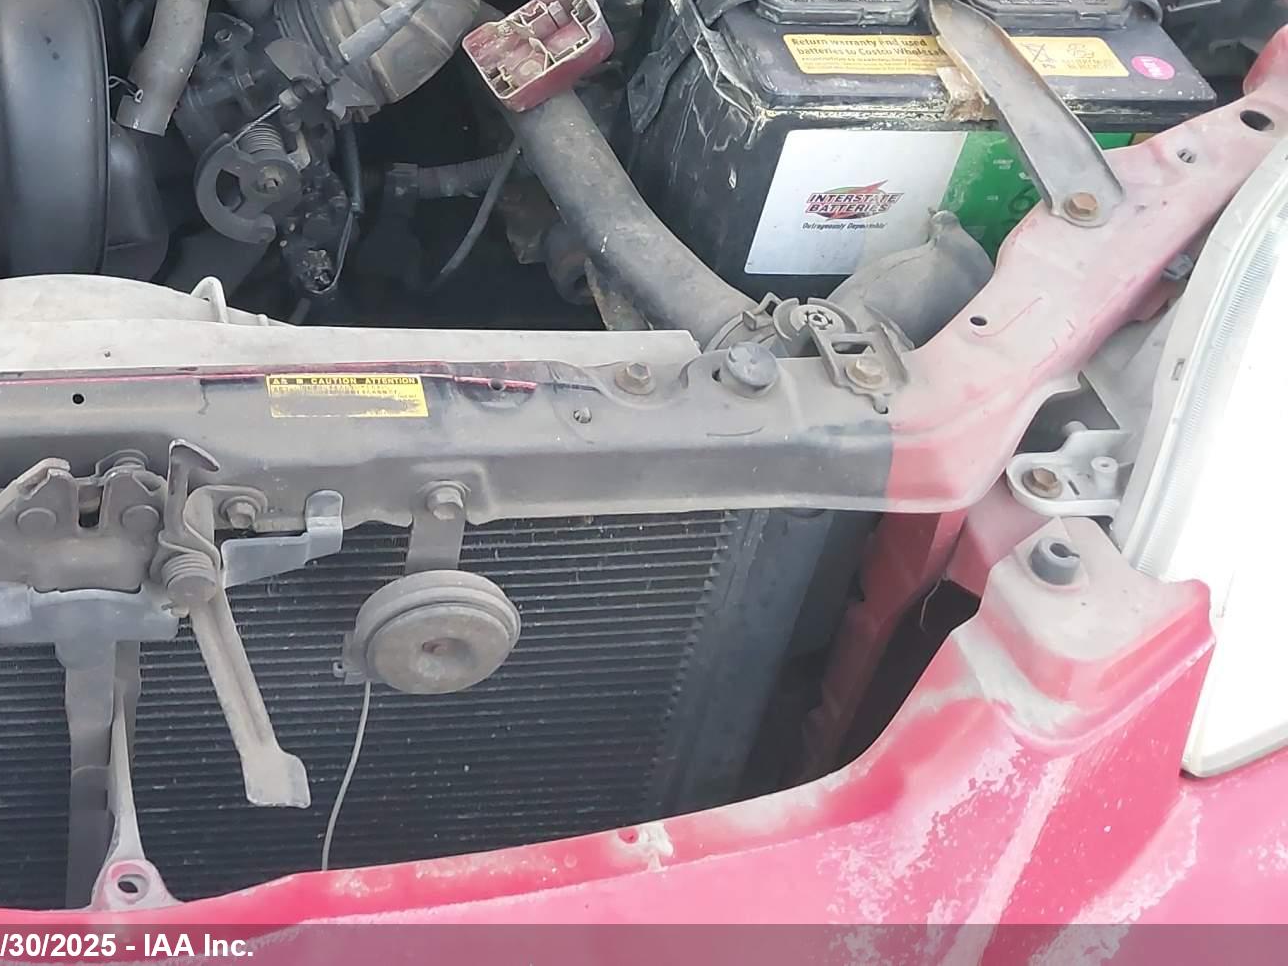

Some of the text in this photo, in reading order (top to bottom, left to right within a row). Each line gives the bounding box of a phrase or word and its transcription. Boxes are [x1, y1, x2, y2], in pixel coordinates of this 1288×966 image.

[792, 37, 828, 46] Return
[830, 38, 877, 48] warranty
[901, 38, 928, 46] used
[797, 47, 844, 55] batteries
[858, 47, 892, 55] Costco
[808, 194, 899, 203] INTERSTATE
[808, 204, 890, 212] BATTERIES
[311, 377, 357, 385] CAUTION
